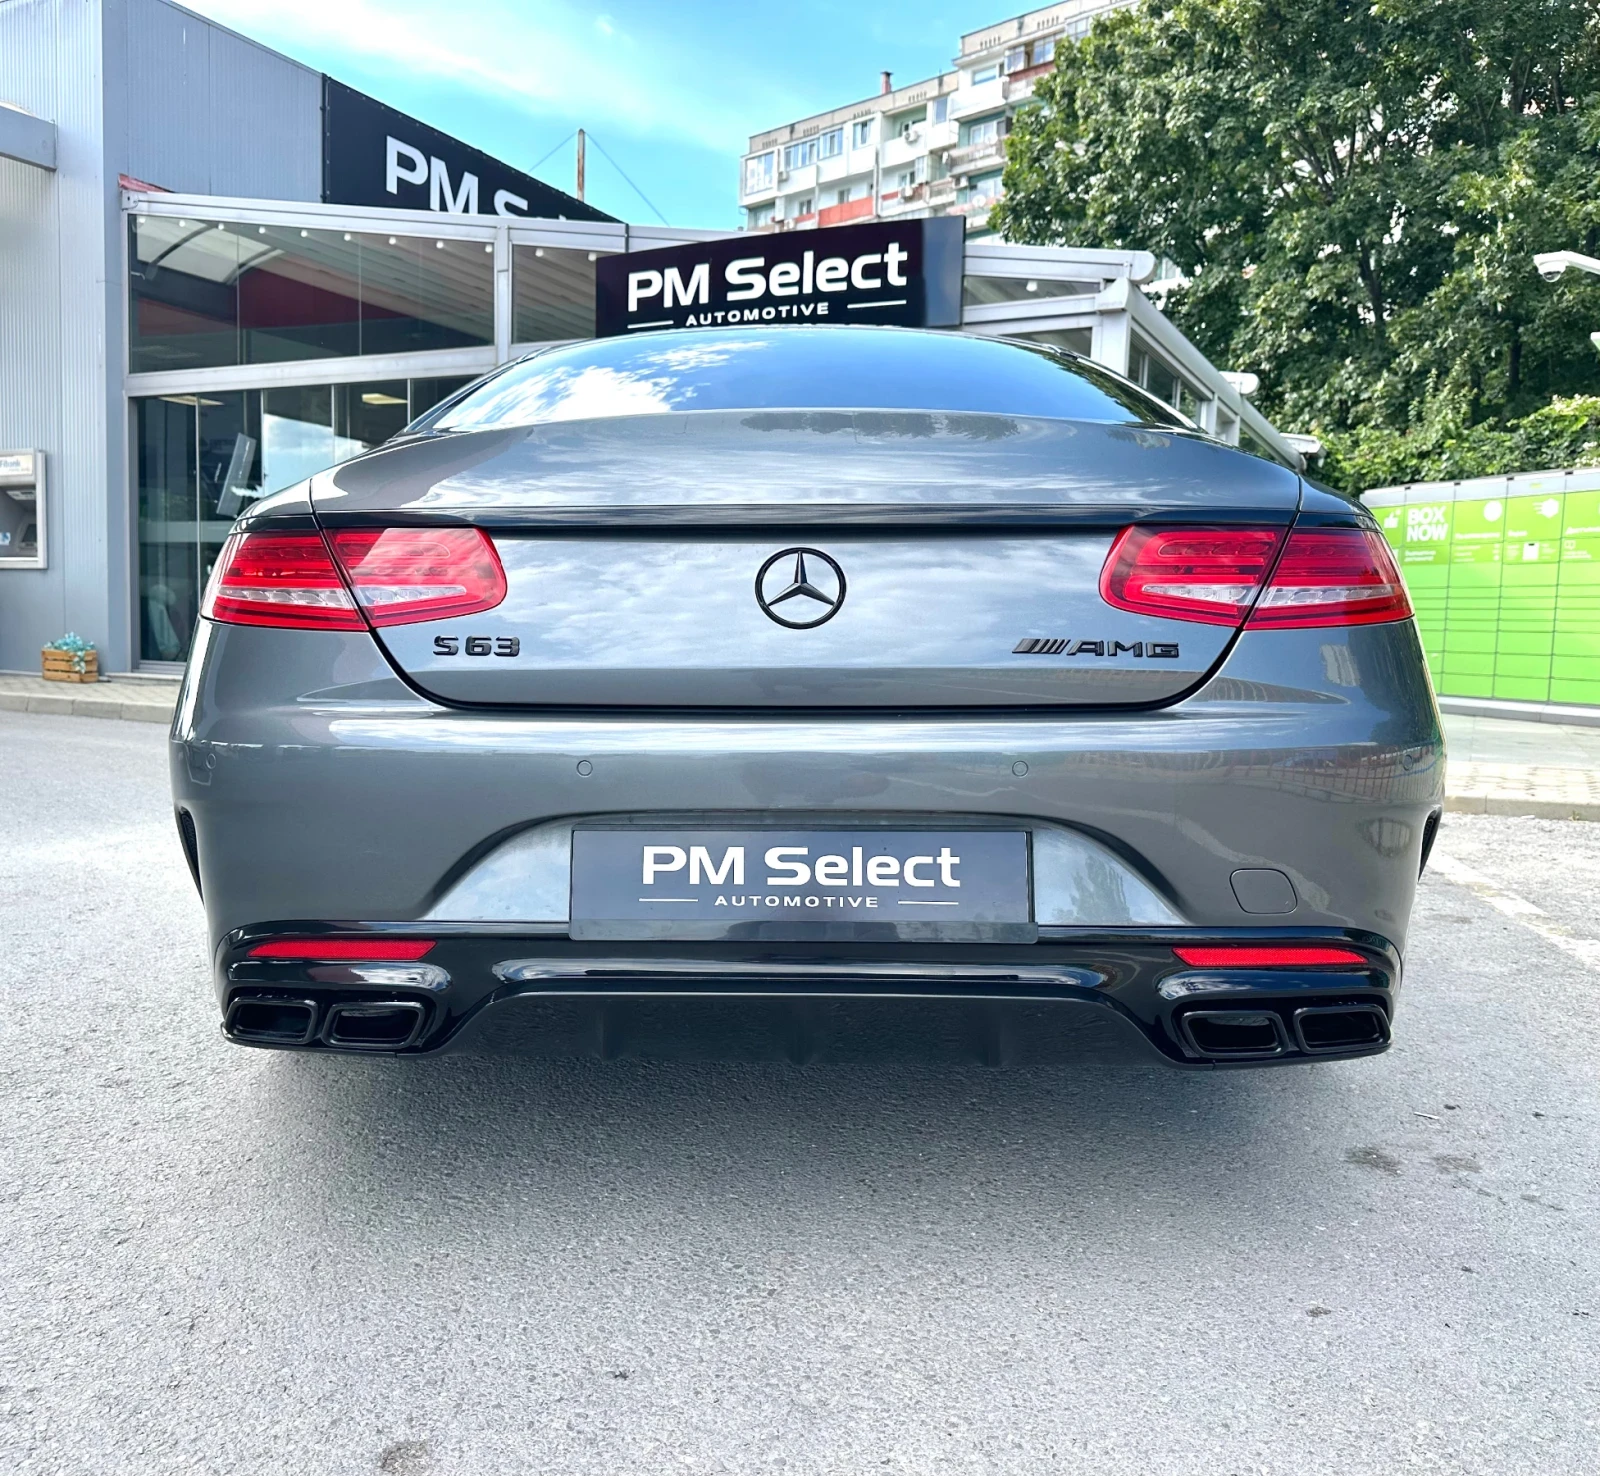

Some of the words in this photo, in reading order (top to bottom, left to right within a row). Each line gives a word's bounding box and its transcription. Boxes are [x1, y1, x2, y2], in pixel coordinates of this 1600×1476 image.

[386, 135, 479, 215] PM
[628, 263, 710, 312] PM
[725, 242, 908, 302] Select
[685, 302, 829, 327] AUTOMOTIVE
[1407, 506, 1447, 525] BOX
[1406, 524, 1449, 542] NOW
[433, 635, 459, 656] S
[465, 635, 520, 657] 63
[1066, 640, 1179, 658] AMG
[642, 846, 745, 885] PM
[764, 846, 961, 887] Select
[714, 895, 878, 908] AUTOMOTIVE
